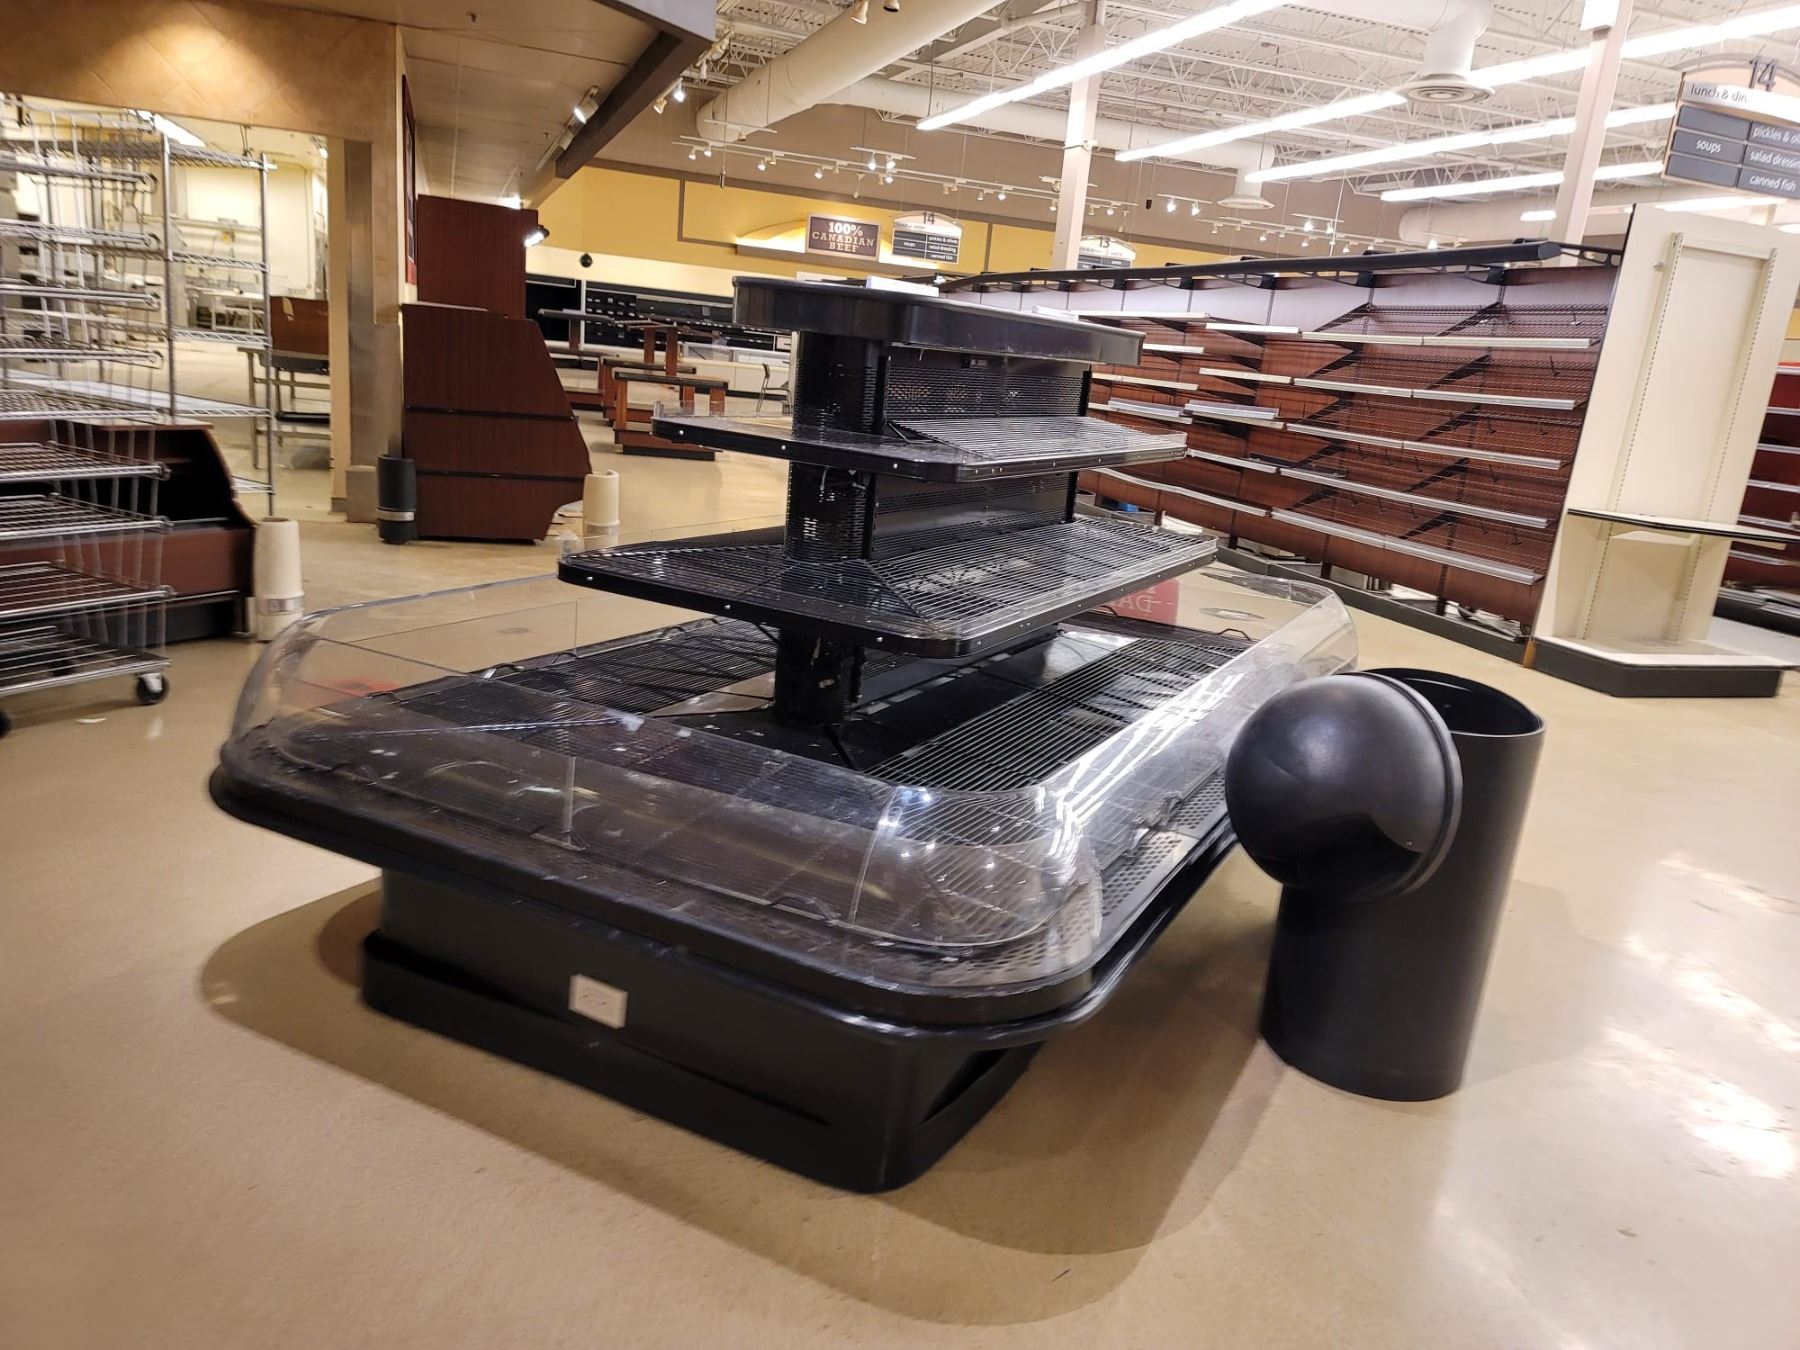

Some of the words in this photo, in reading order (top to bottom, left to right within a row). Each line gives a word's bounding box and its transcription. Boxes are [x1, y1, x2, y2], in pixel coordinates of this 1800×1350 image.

[1750, 56, 1778, 92] 14
[1690, 83, 1719, 98] lunch
[1721, 89, 1729, 100] &
[1731, 91, 1748, 103] din
[1752, 126, 1782, 140] pickles
[1782, 131, 1790, 142] &
[1696, 139, 1722, 154] soups
[1750, 149, 1774, 164] salad
[1750, 175, 1781, 189] canned
[1780, 177, 1797, 192] fish
[921, 211, 935, 225] 14
[828, 221, 864, 237] 100%
[812, 231, 875, 247] CANADIAN
[1098, 236, 1110, 249] 13
[829, 242, 859, 253] BEEF
